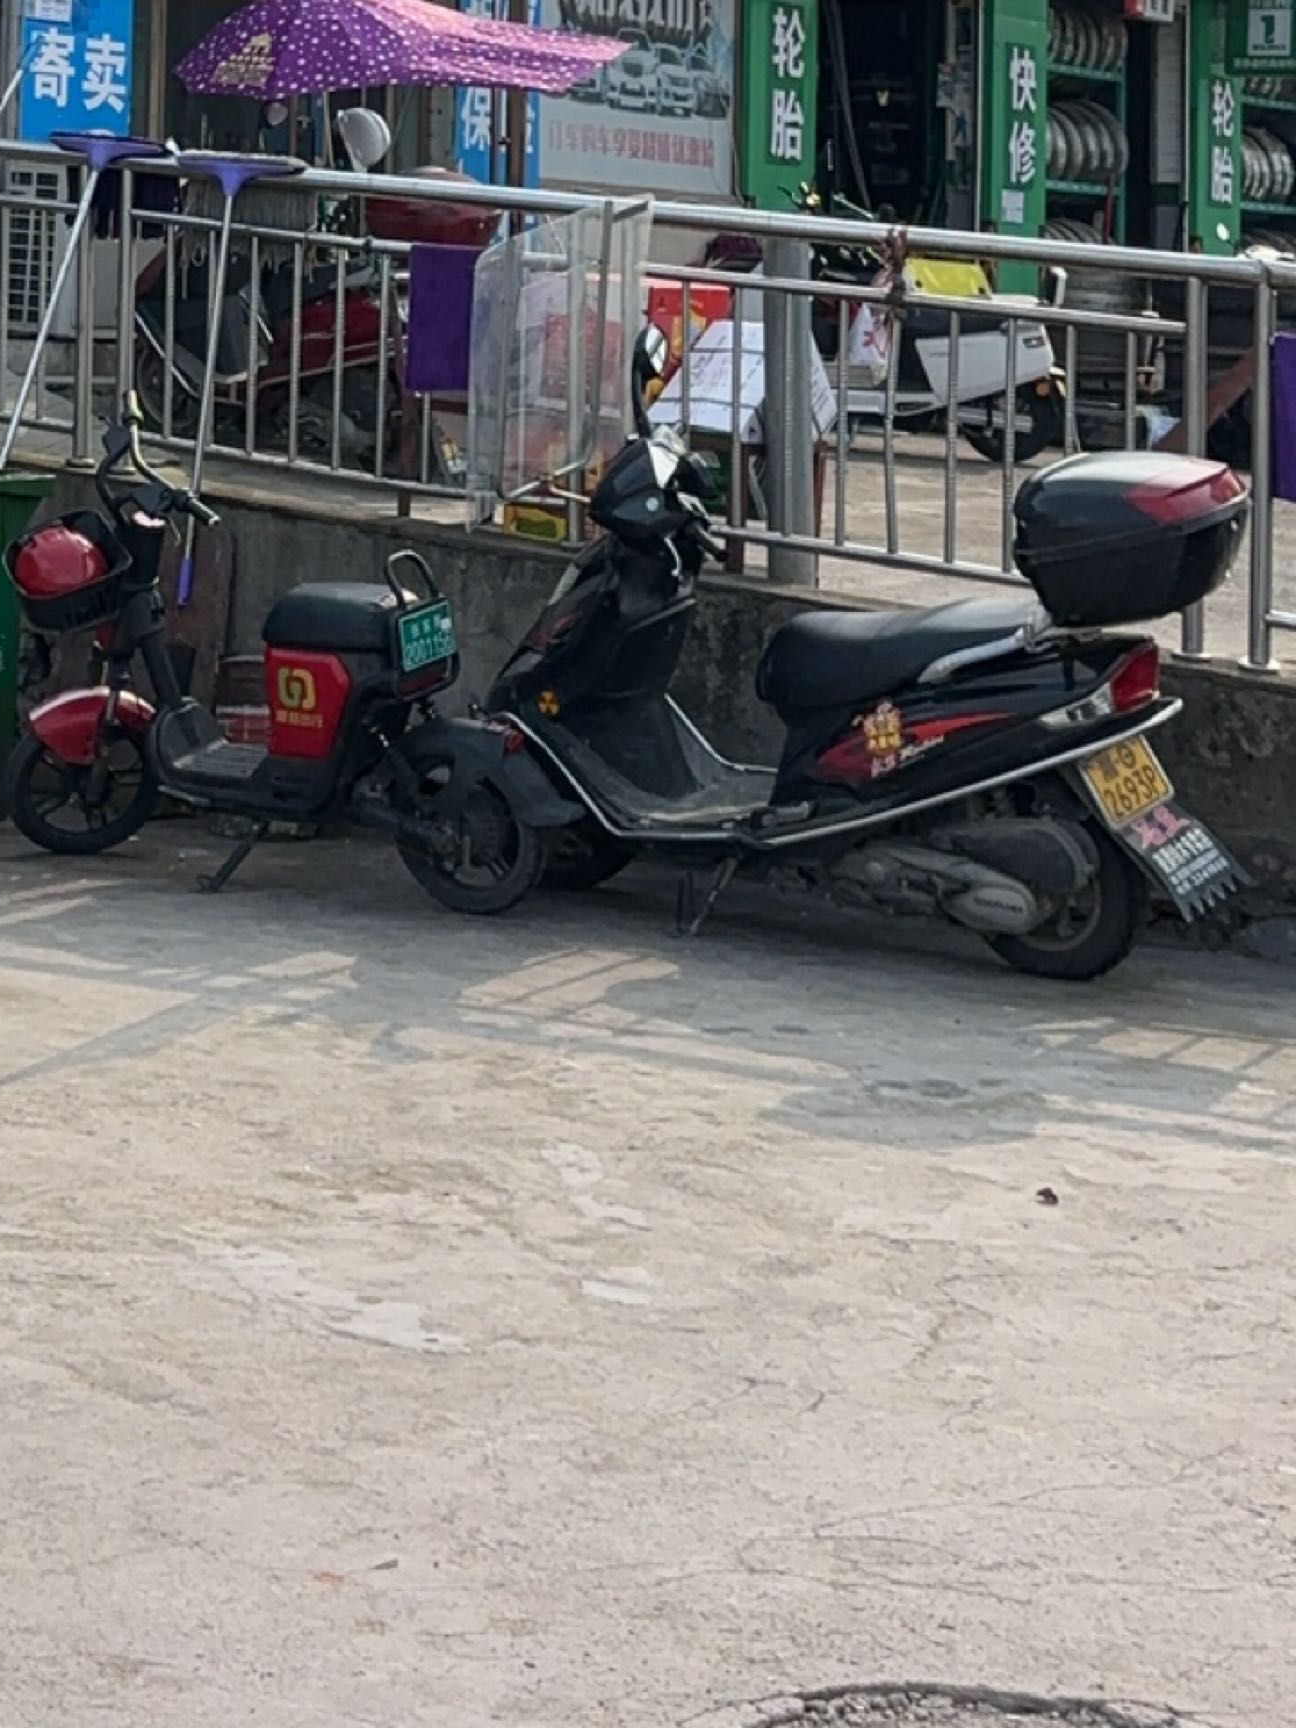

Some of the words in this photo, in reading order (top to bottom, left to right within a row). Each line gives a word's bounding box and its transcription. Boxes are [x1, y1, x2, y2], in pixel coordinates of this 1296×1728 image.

[29, 26, 128, 114] 寄卖
[771, 6, 806, 162] 轮胎
[1008, 47, 1038, 185] 快修
[1210, 79, 1236, 204] 轮胎
